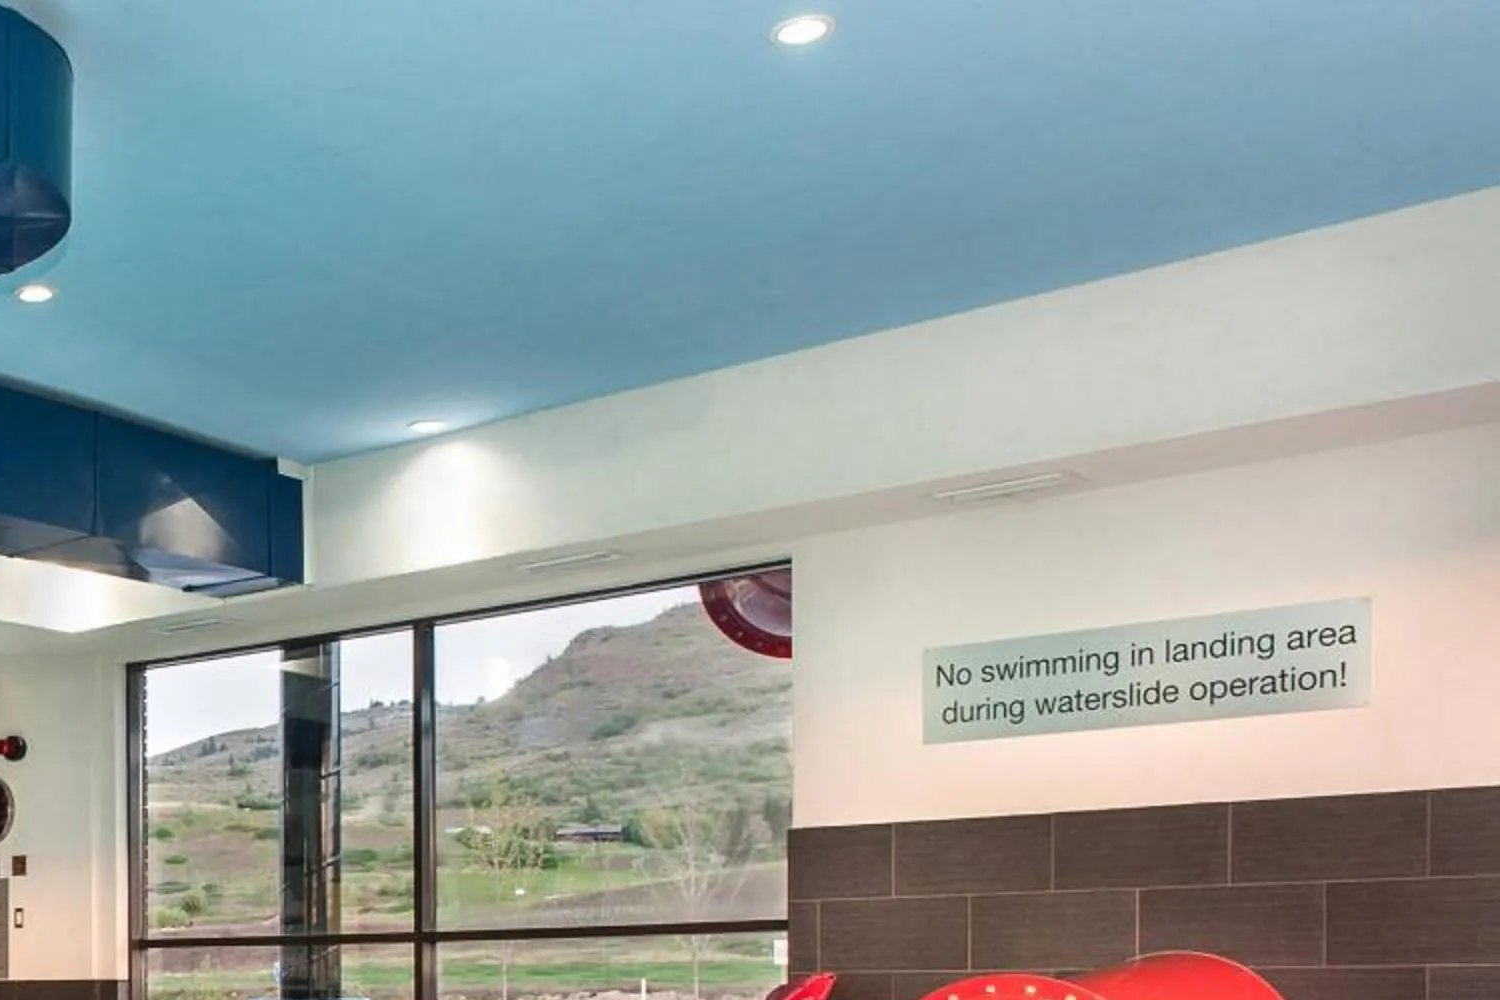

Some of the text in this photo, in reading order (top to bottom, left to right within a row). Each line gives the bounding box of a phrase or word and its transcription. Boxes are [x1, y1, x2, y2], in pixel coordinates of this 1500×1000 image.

[936, 624, 1358, 688] No swimming in landing area
[942, 661, 1348, 725] during waterslide operation!
